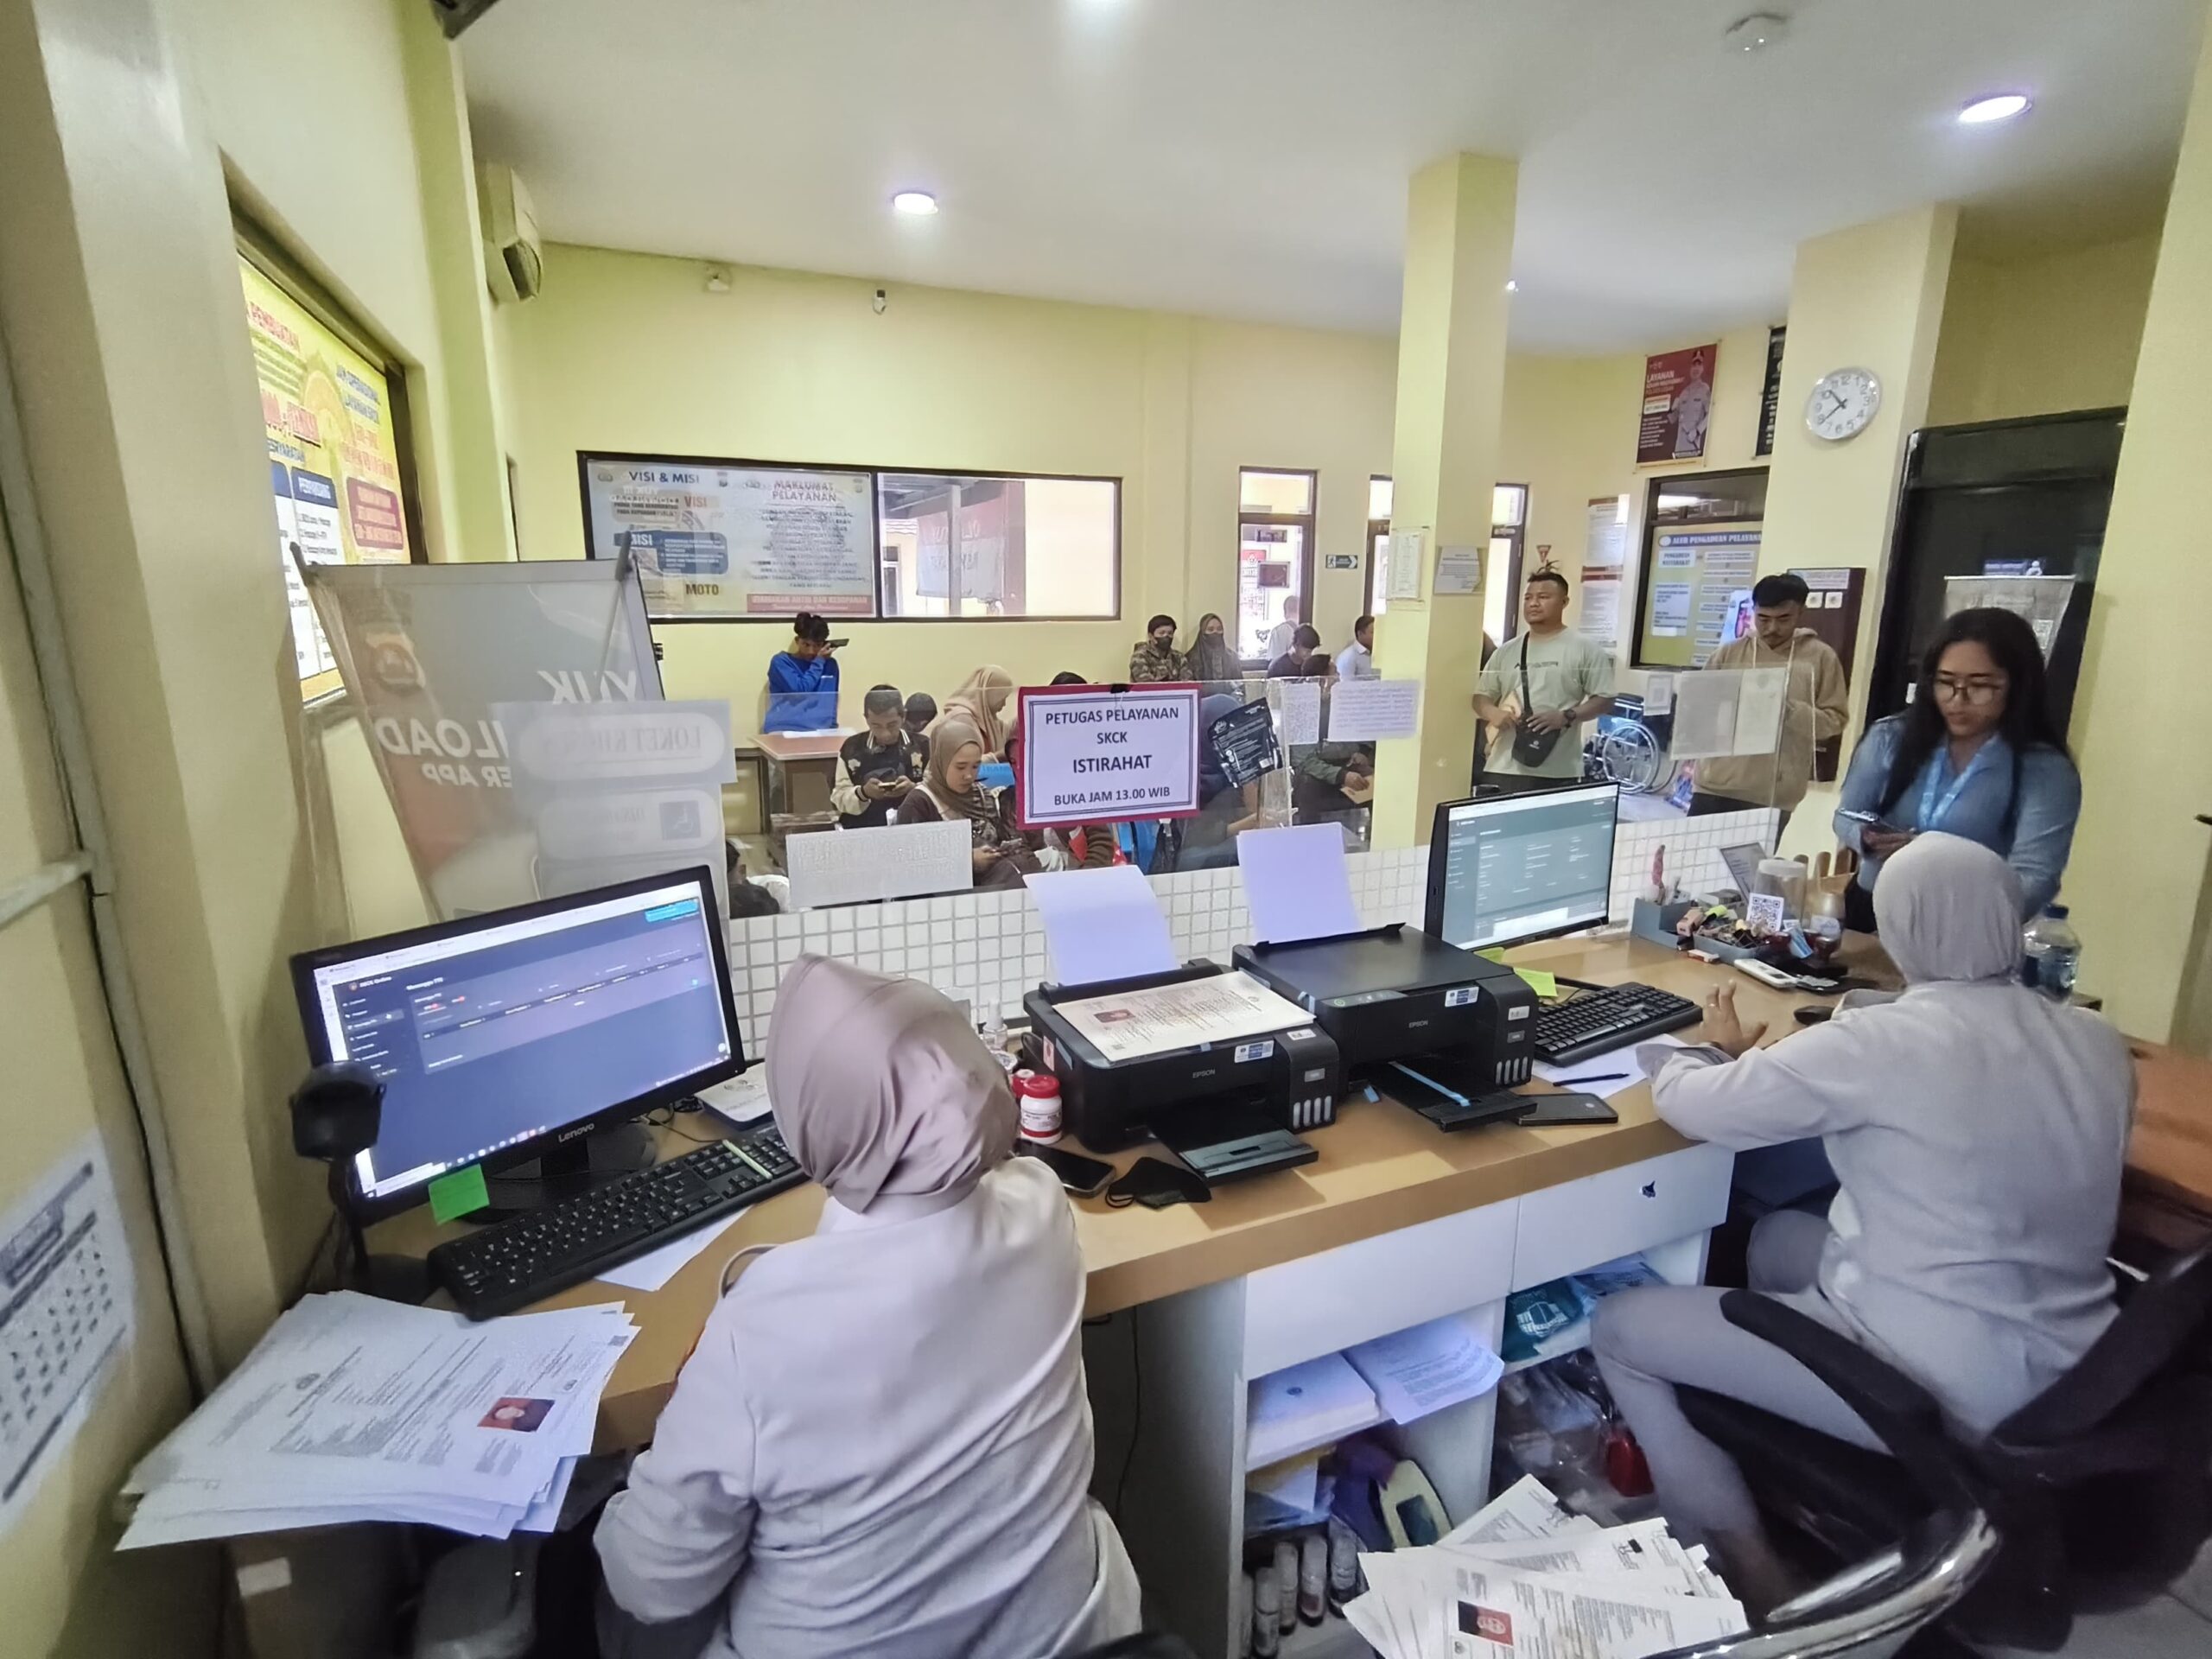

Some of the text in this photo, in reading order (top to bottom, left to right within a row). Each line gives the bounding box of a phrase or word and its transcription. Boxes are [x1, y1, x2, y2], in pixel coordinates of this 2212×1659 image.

[1840, 375, 1850, 385] 12
[1859, 385, 1867, 395] 2
[1863, 397, 1870, 406] 3
[1835, 424, 1842, 434] 6
[629, 471, 699, 484] VISI & MISI
[684, 496, 708, 508] VISI
[772, 492, 836, 501] PELAYANAN
[685, 583, 719, 595] MOTO
[1046, 707, 1179, 725] PETUGAS PELAYANAN
[1096, 732, 1128, 744] SKCK
[1073, 754, 1153, 773] ISTIRAHAT
[1054, 786, 1170, 805] BUKA JAM 13.00 WIB
[1192, 1068, 1216, 1078] EPSON
[558, 1122, 595, 1143] Lenovo
